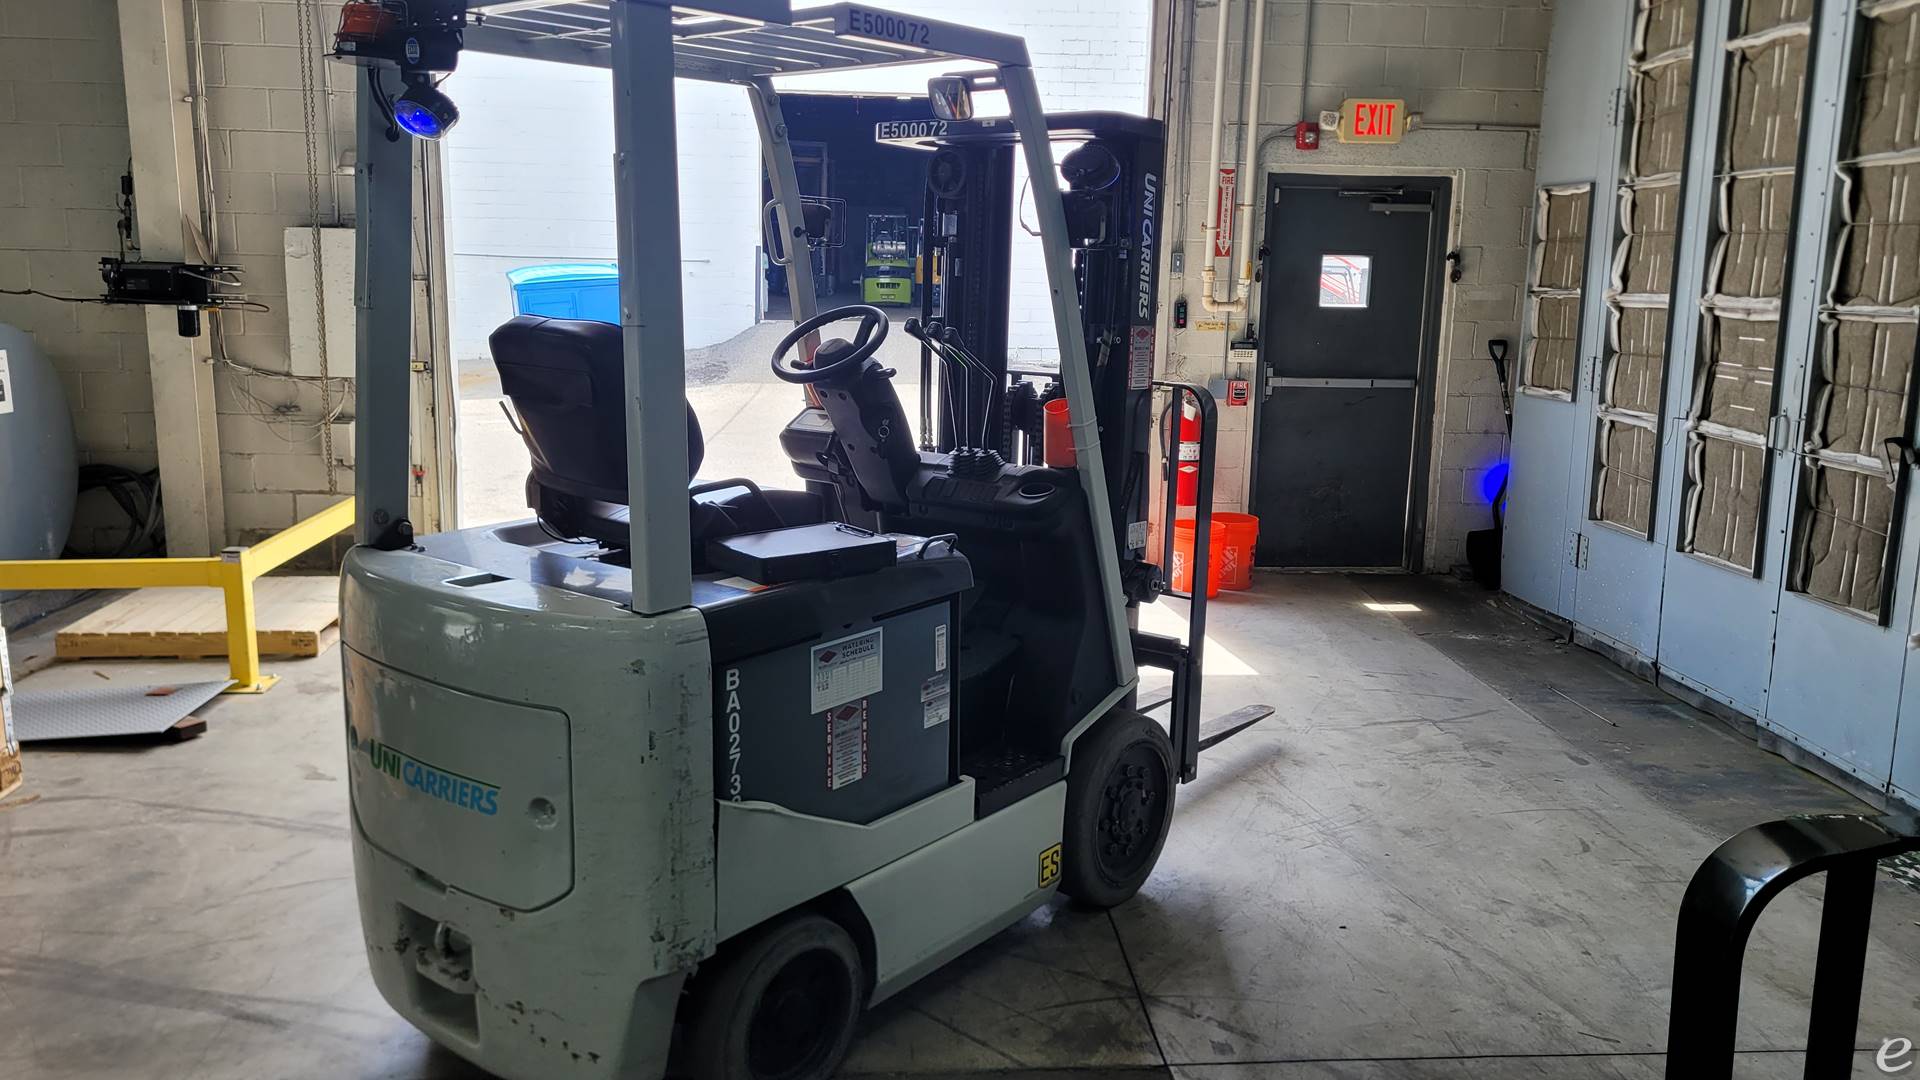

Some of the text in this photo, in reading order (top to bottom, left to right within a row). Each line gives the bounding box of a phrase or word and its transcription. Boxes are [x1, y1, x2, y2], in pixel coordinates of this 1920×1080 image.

[849, 8, 930, 45] E500072
[881, 120, 948, 138] E500072
[1354, 103, 1396, 136] EXIT
[1222, 176, 1234, 185] FIRE
[842, 643, 874, 659] SCHEDULE
[1040, 849, 1059, 883] ES
